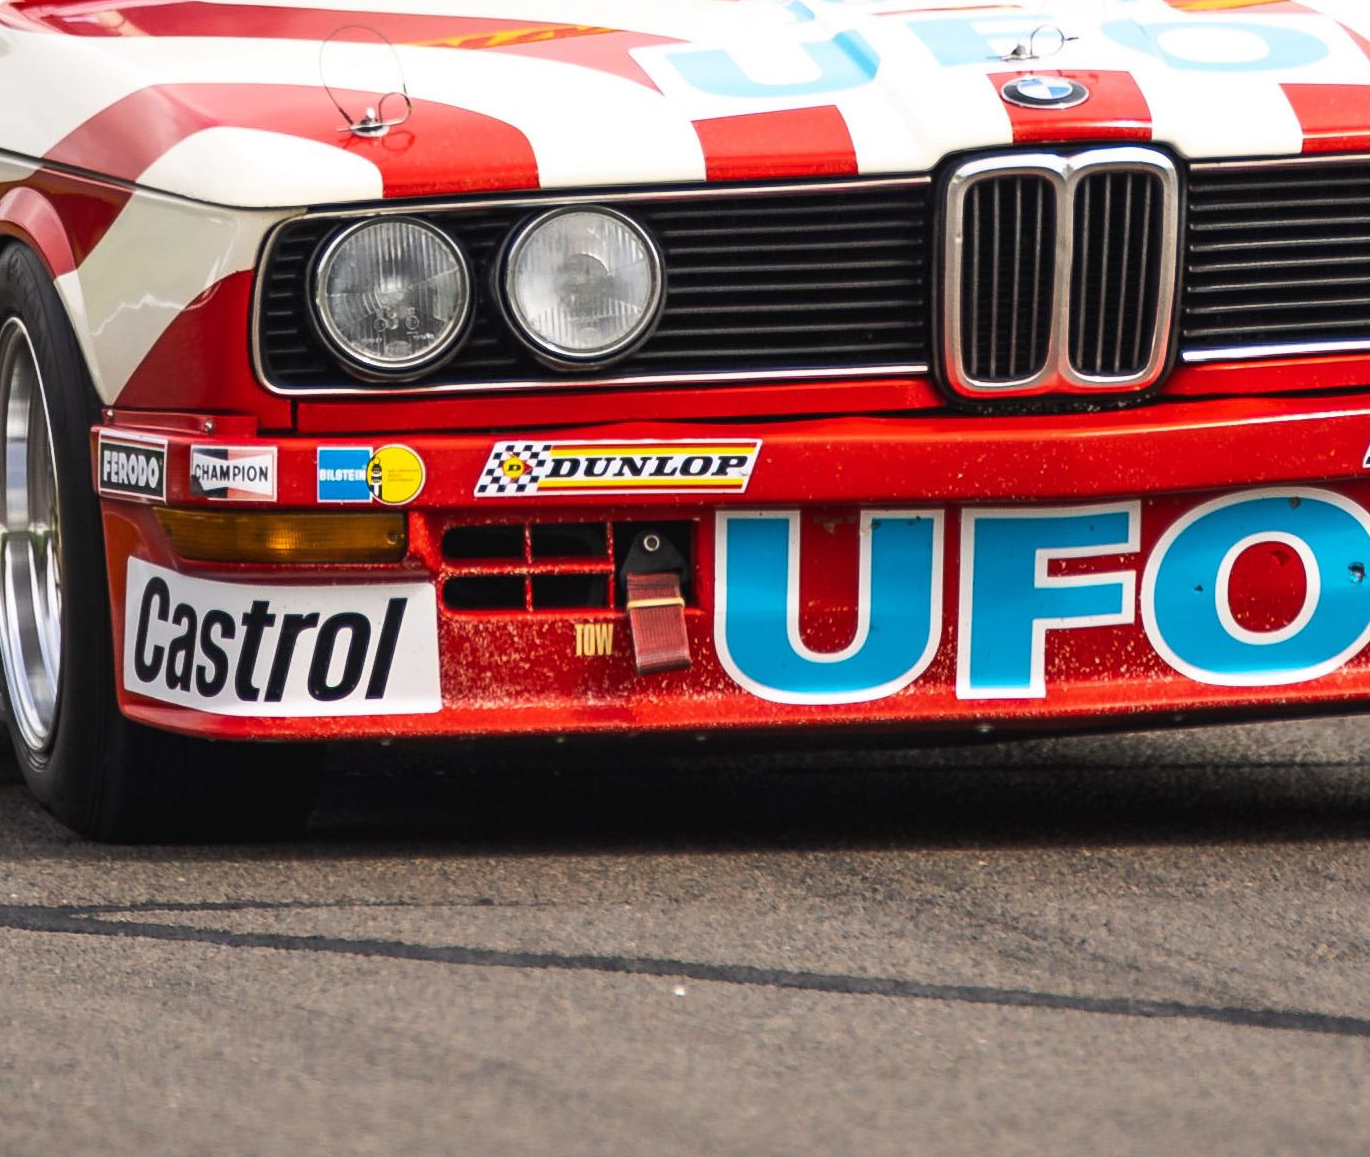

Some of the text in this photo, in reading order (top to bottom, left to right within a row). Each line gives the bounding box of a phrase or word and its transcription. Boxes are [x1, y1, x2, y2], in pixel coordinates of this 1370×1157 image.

[665, 14, 1332, 99] UFO
[103, 450, 161, 489] FERODO
[193, 463, 270, 483] CHAMPION
[319, 468, 366, 482] BILSTEIN
[545, 455, 748, 479] DUNLOP
[135, 576, 408, 702] Castrol
[574, 622, 613, 657] TOW
